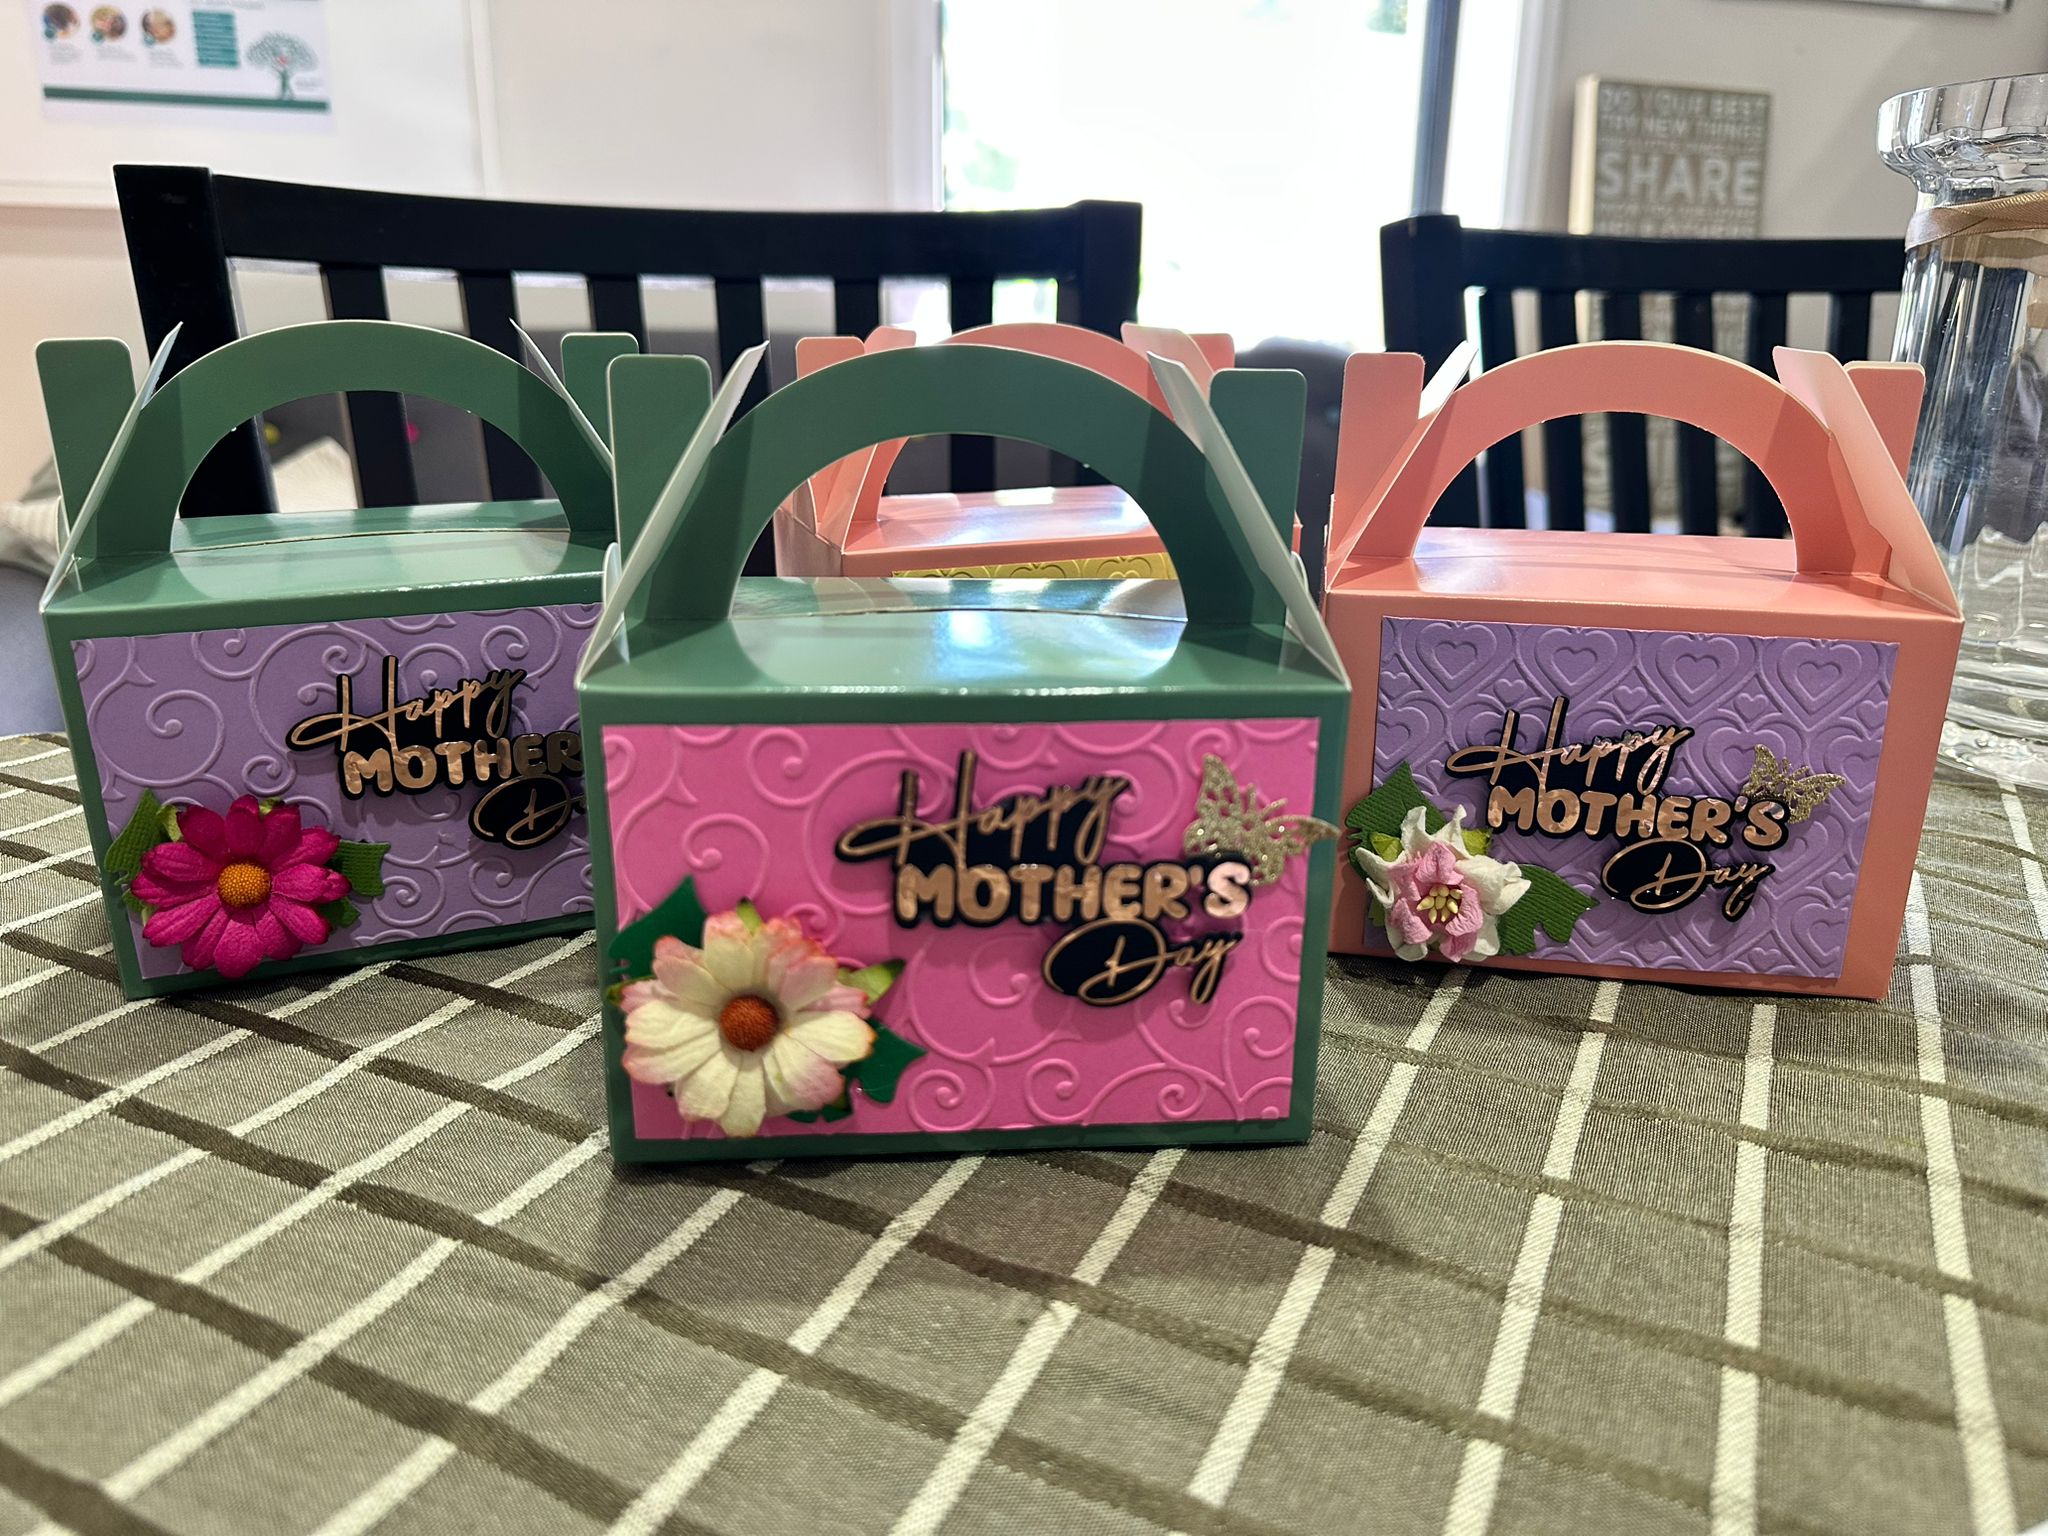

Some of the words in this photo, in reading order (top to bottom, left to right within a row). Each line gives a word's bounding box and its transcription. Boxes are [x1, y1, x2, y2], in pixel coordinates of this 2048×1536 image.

[1598, 151, 1761, 206] SHARE
[289, 655, 526, 752] Happy
[342, 730, 583, 795] MOTHER
[1446, 696, 1693, 794] Happy
[838, 751, 1130, 866] Happy
[1487, 785, 1786, 847] MOTHER'S
[897, 861, 1252, 923] MOTHER'S
[1602, 838, 1774, 918] Day
[1042, 917, 1241, 1003] Day
